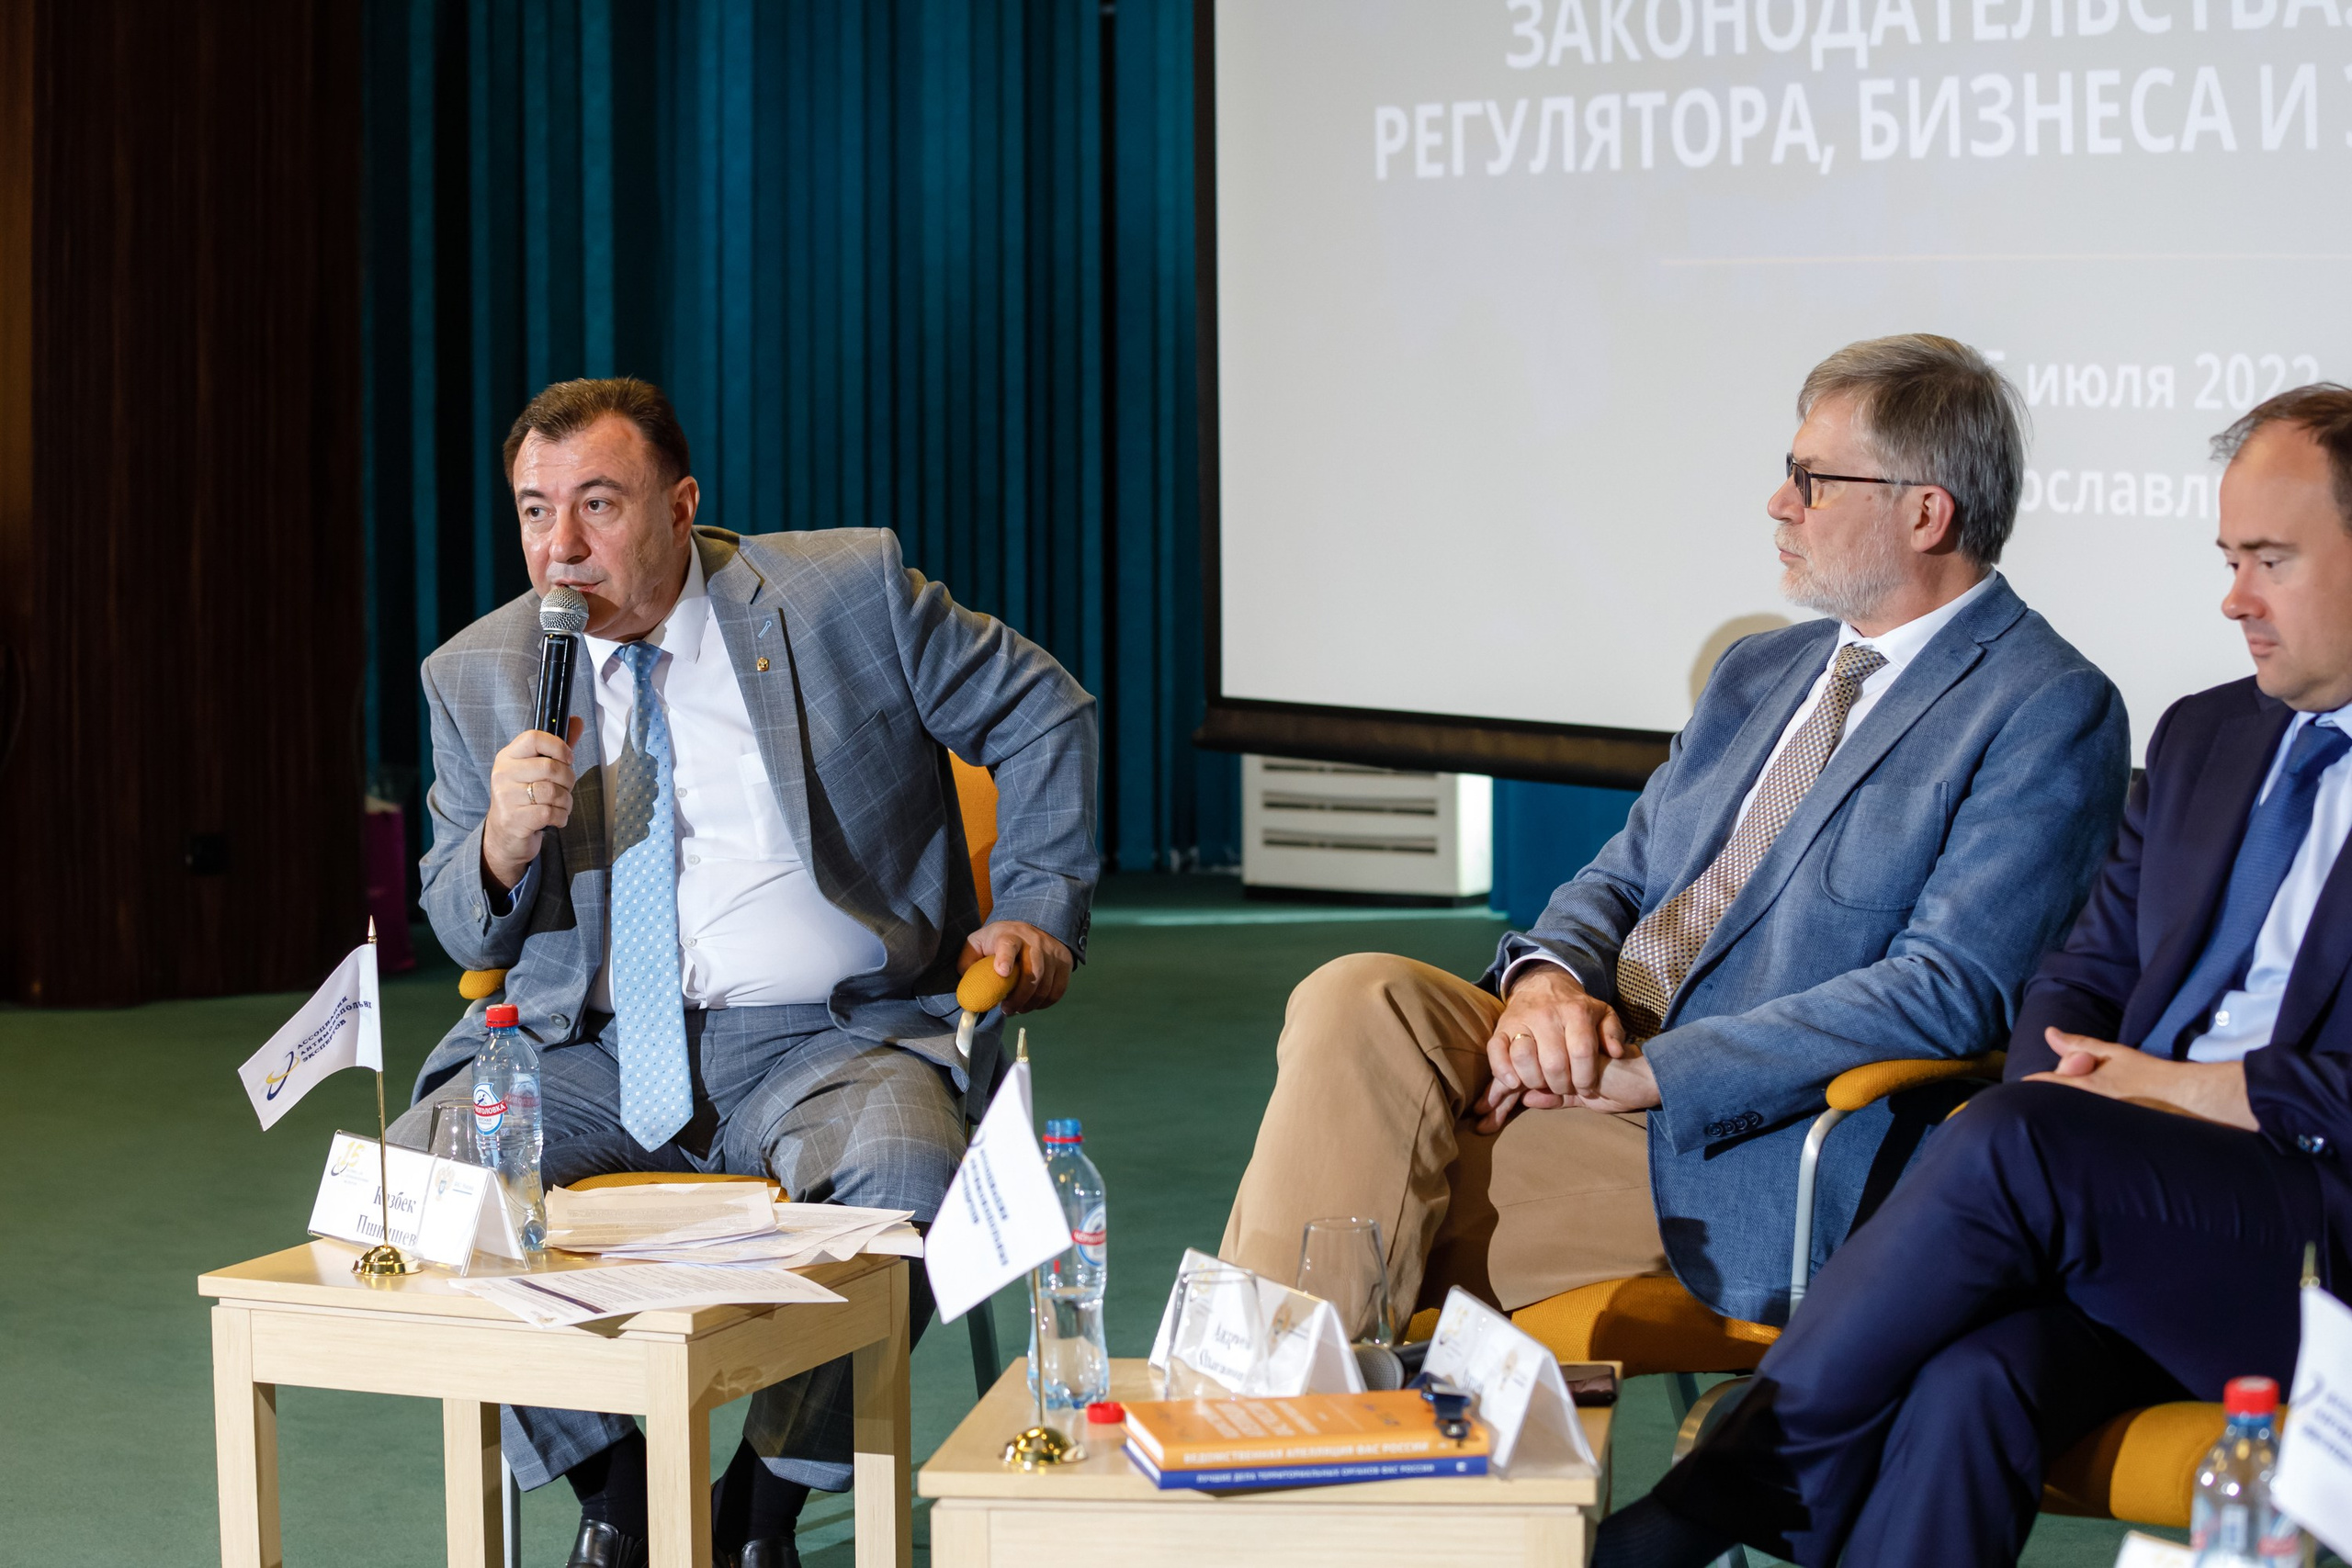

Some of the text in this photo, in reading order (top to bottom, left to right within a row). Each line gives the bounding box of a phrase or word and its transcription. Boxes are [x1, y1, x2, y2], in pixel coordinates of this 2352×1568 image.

[1374, 83, 1835, 180] РЕГУЛЯТОРА,
[1859, 66, 2238, 162] БИЗНЕСА
[2259, 62, 2318, 151] И
[2027, 363, 2176, 410] июля
